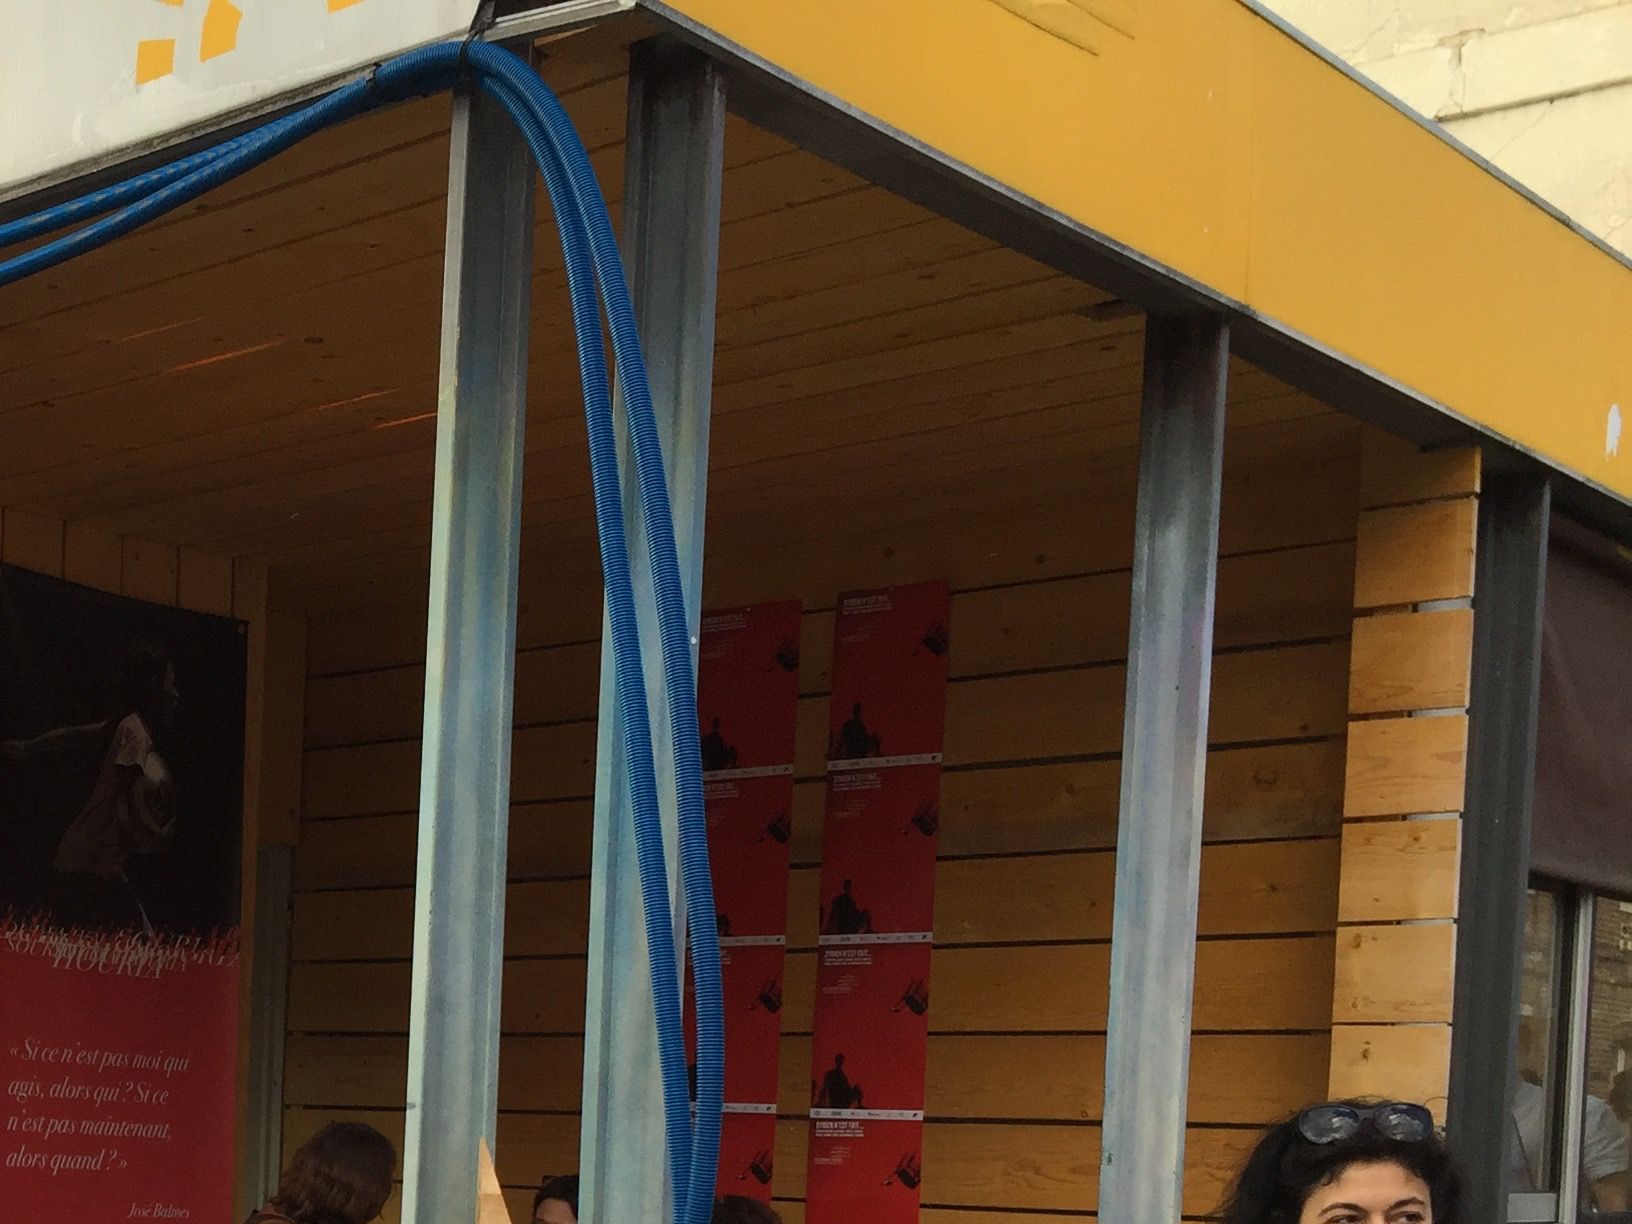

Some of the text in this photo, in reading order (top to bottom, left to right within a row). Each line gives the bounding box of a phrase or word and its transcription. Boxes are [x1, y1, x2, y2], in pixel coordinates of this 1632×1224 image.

[21, 1039, 41, 1061] Si
[41, 1048, 58, 1062] ce
[98, 1050, 129, 1072] pas
[132, 1050, 162, 1071] moi
[164, 1053, 190, 1077] qui
[7, 1075, 45, 1103] agis,
[49, 1076, 90, 1100] alors
[94, 1081, 120, 1107] qui
[135, 1081, 152, 1104] Si
[152, 1089, 169, 1104] ce
[44, 1117, 77, 1140] pas
[6, 1144, 50, 1168] alors
[51, 1148, 105, 1176] quand
